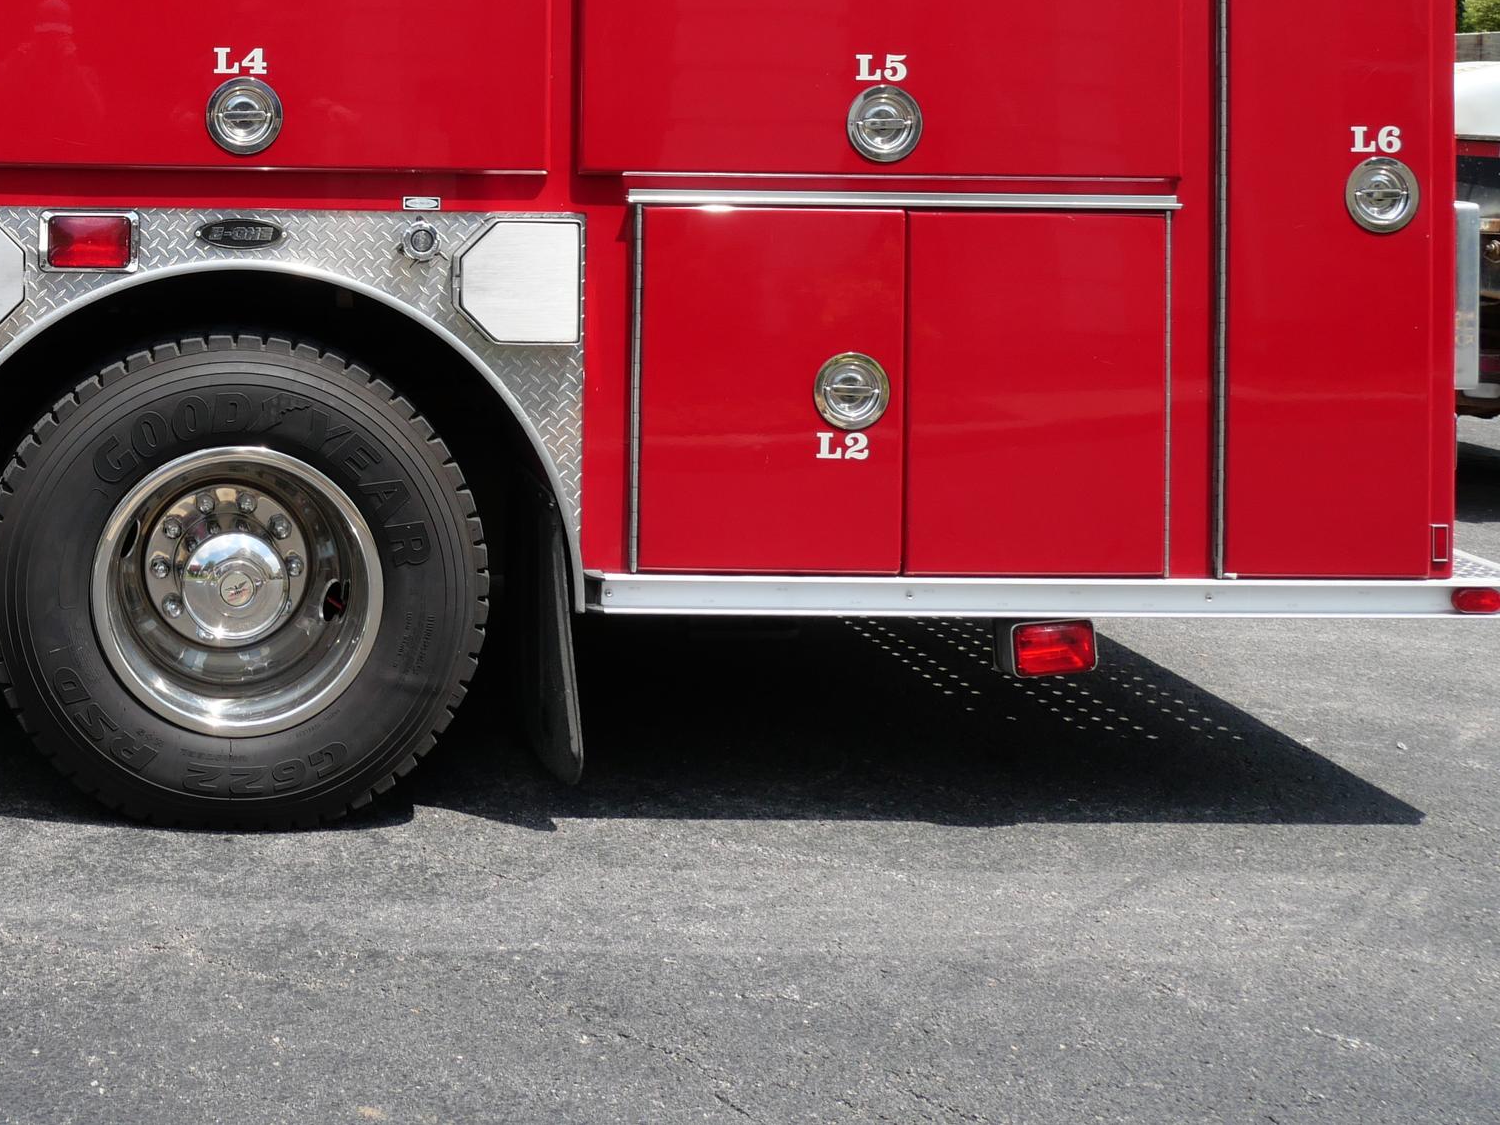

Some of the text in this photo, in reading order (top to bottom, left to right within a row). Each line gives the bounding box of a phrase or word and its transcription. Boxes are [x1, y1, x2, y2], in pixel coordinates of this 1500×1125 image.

[213, 47, 268, 74] L4
[855, 54, 908, 81] L5
[1350, 125, 1402, 153] L6
[208, 226, 273, 242] E-ONE
[815, 432, 869, 460] L2
[91, 391, 433, 568] GOODYEAR
[50, 667, 159, 773] RSD
[182, 741, 350, 796] G622
